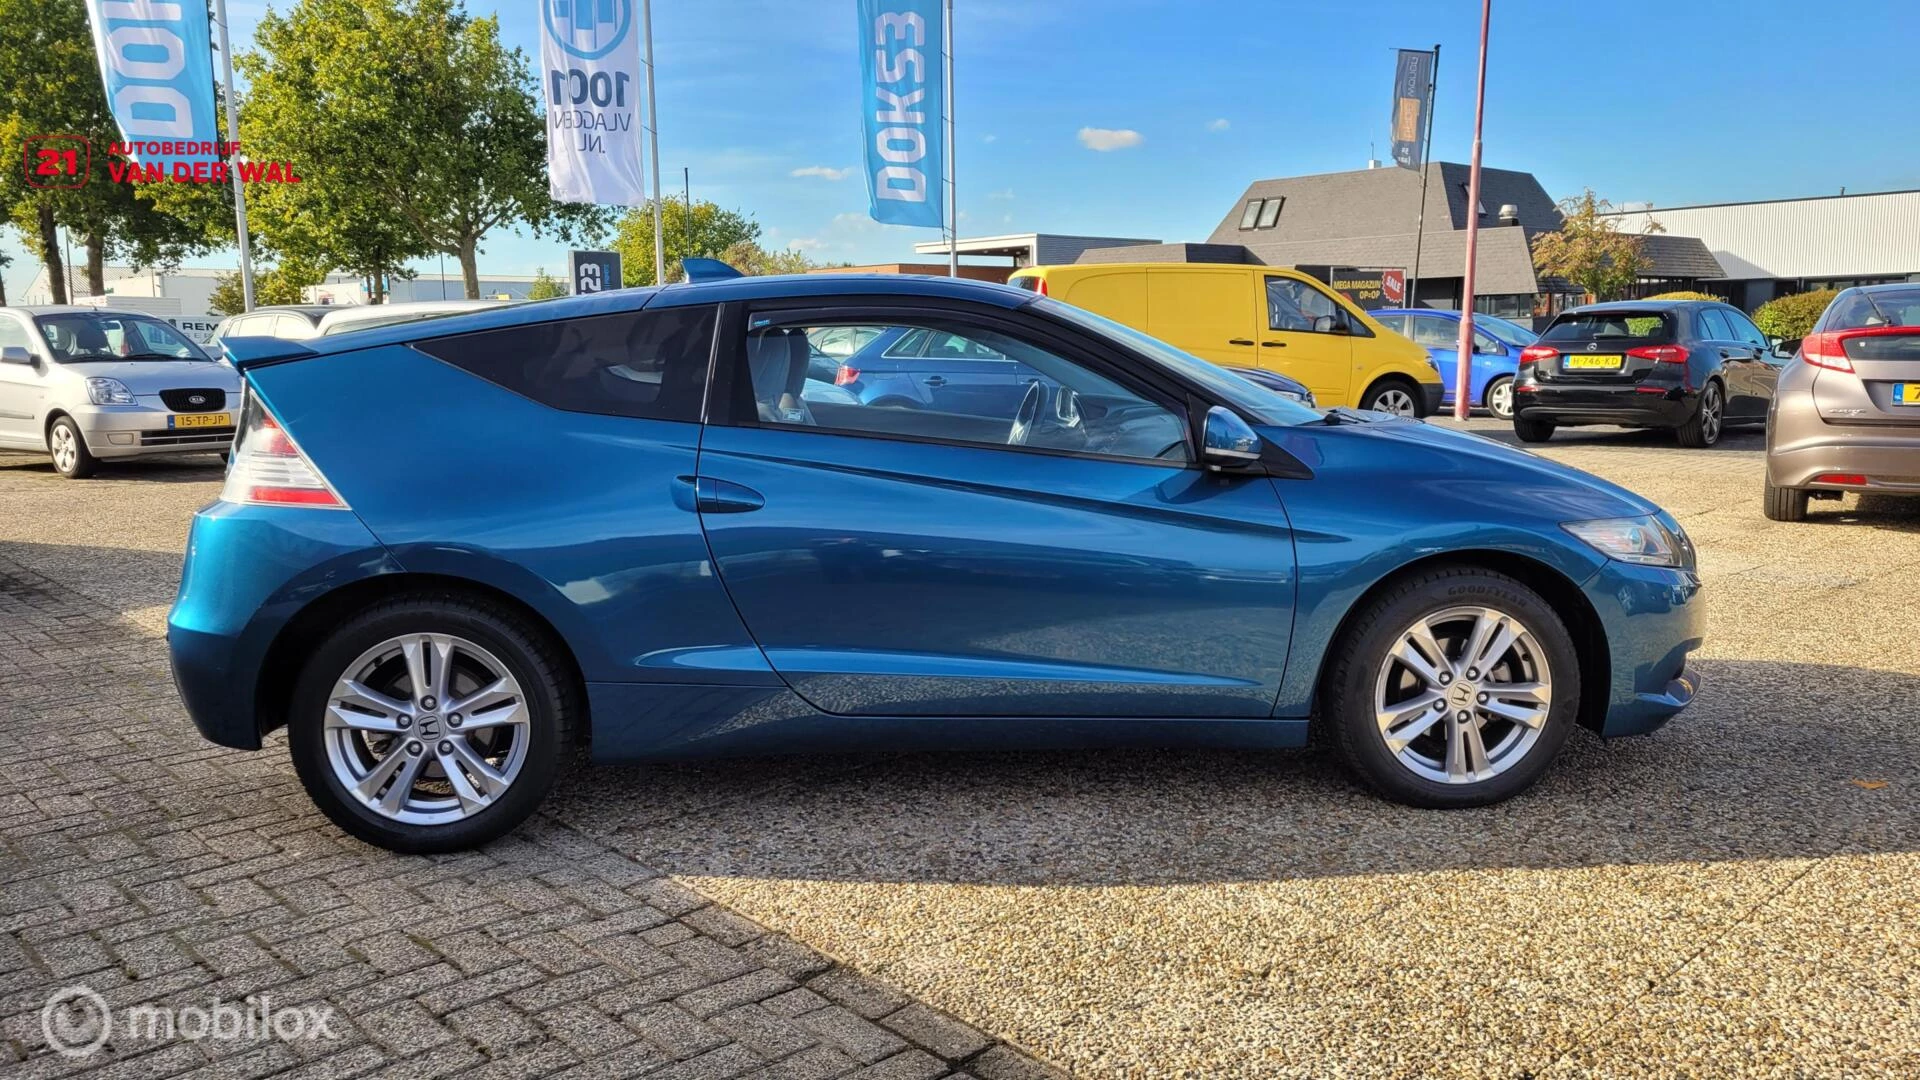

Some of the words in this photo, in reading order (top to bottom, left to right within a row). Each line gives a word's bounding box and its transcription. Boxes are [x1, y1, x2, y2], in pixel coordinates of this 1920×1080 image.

[1333, 281, 1351, 289] MEGA
[1385, 275, 1402, 294] SALE
[181, 415, 225, 426] 15-TP-JP
